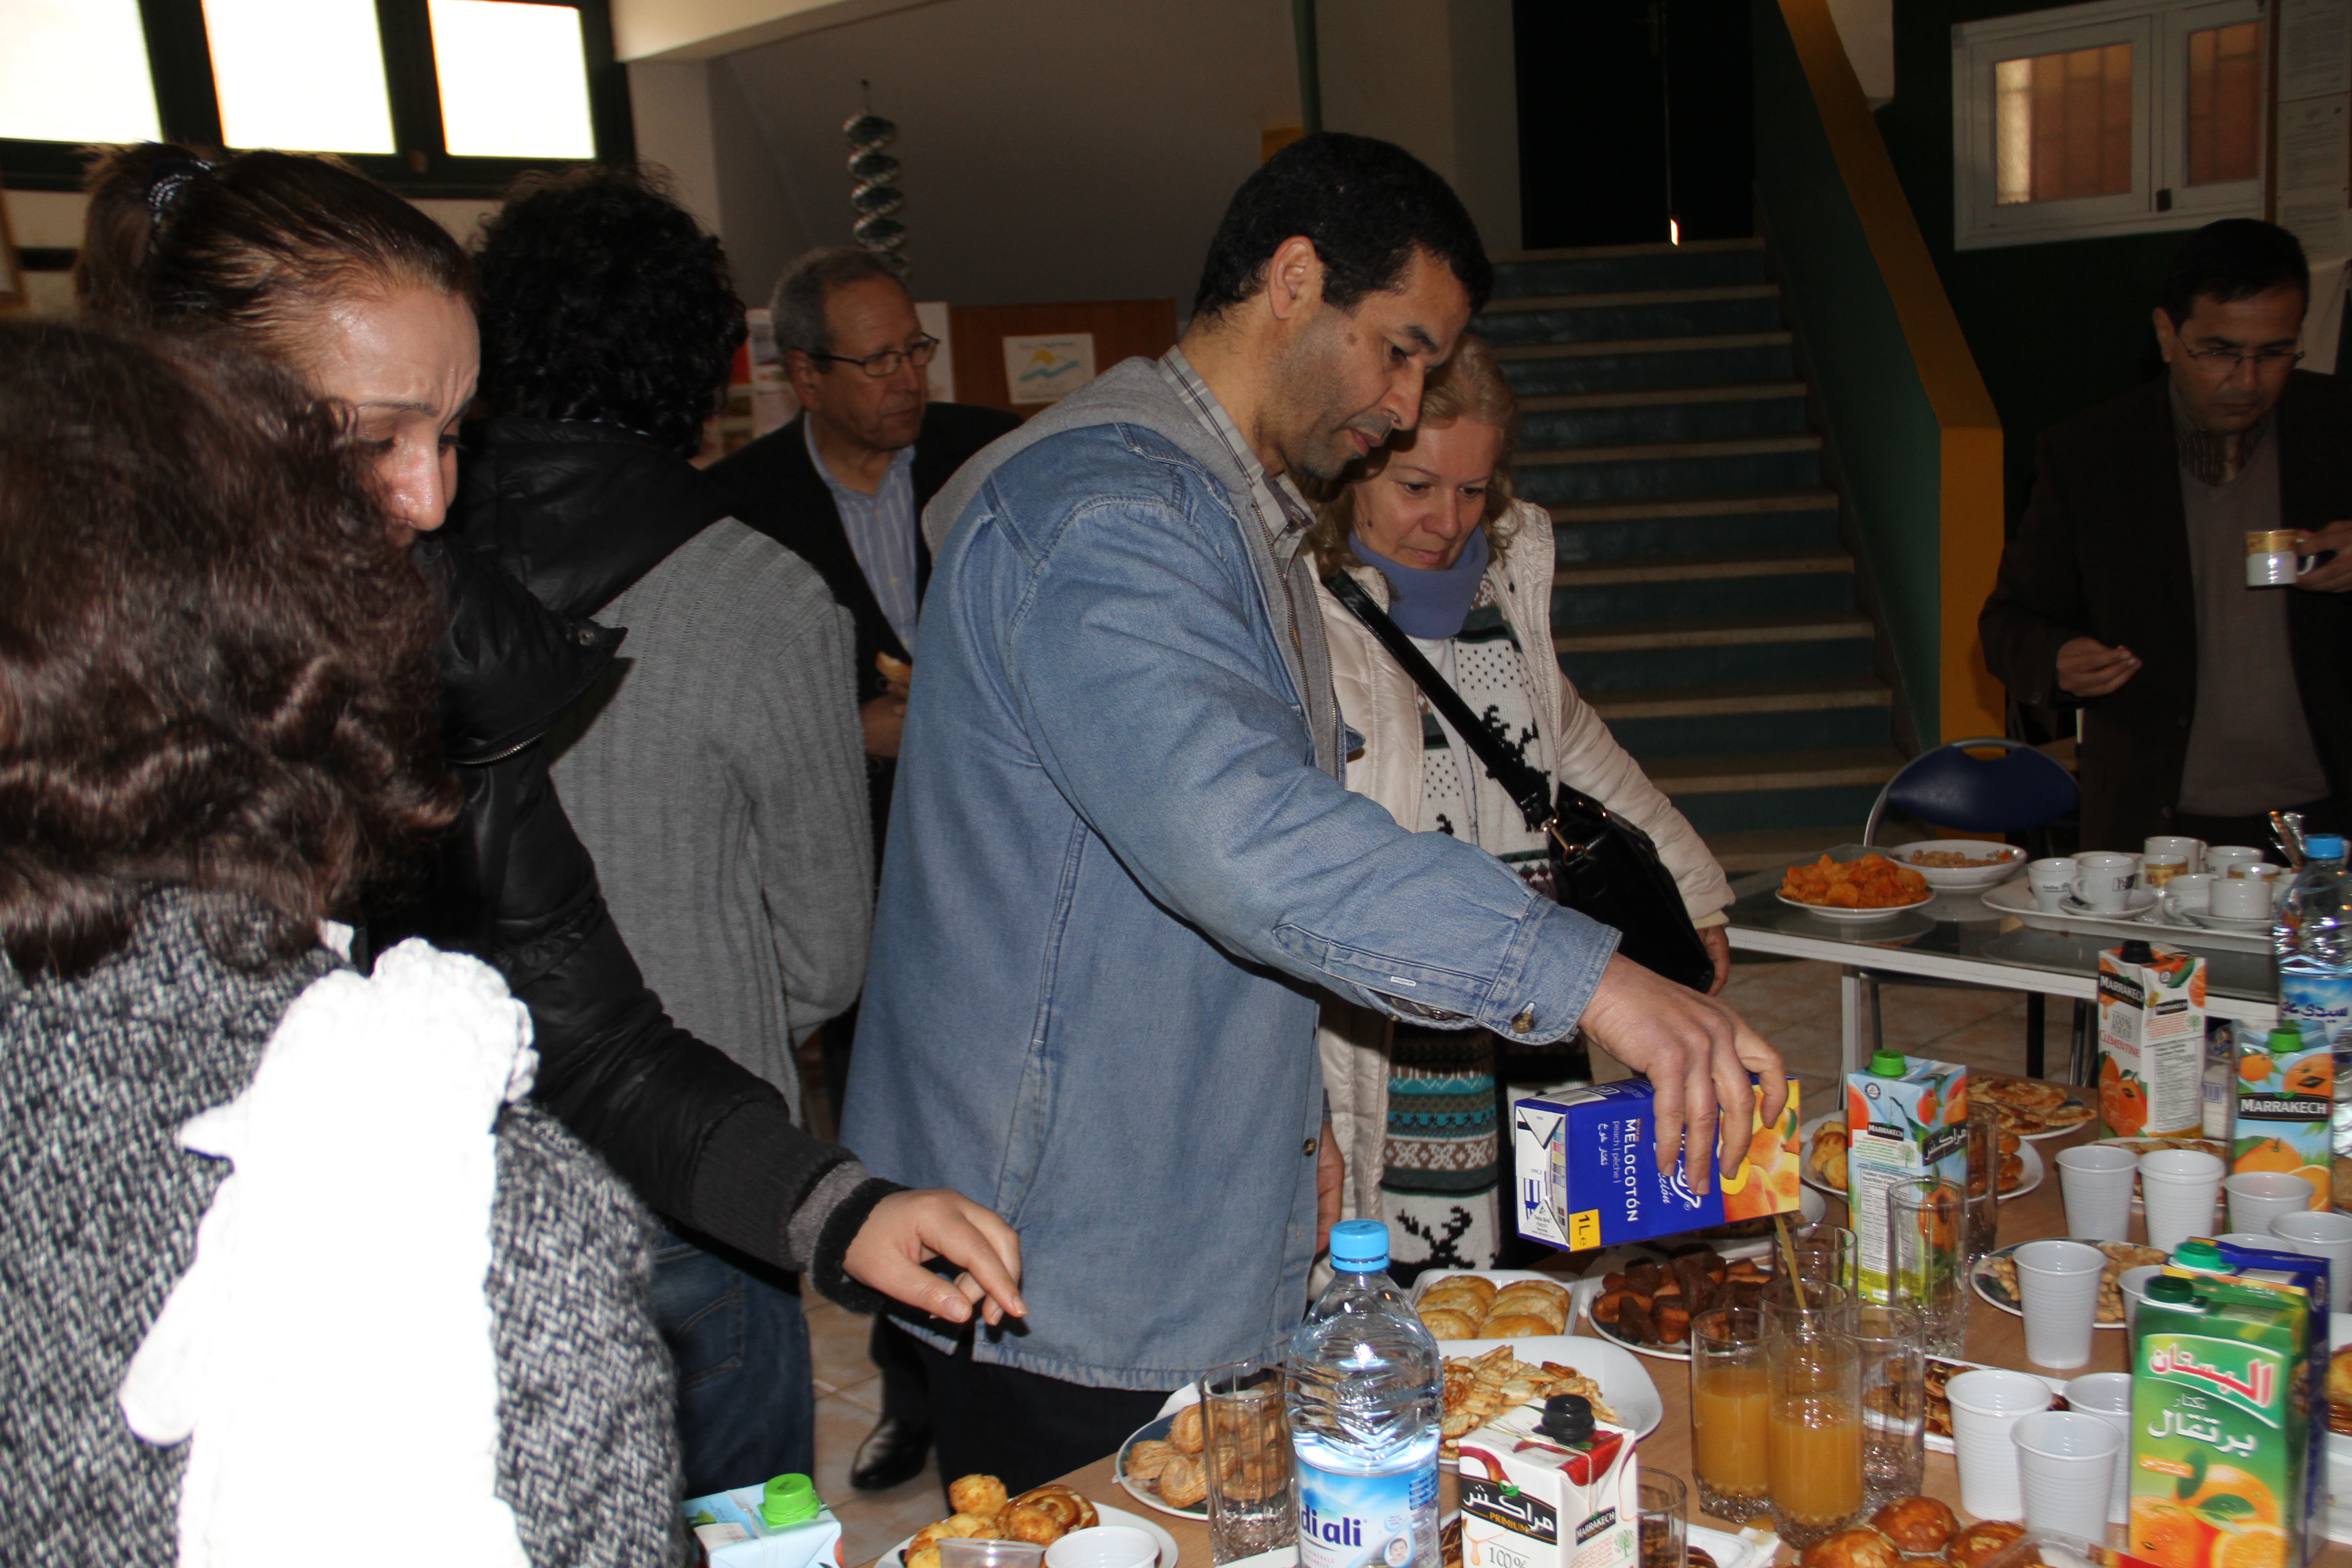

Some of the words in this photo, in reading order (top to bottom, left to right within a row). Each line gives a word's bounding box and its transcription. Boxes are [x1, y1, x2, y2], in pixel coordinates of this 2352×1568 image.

[2100, 975, 2144, 1002] MARRAKECH
[2240, 1099, 2328, 1114] MARRAKECH
[1612, 1120, 1621, 1147] peach
[1868, 1124, 1904, 1138] MARRAKECH
[1611, 1153, 1621, 1179] pêche
[1624, 1118, 1641, 1222] MELOCOTÓN
[2149, 1342, 2274, 1409] البستان
[2147, 1408, 2257, 1458] برتقال
[1463, 1484, 1555, 1533] مراكش
[1322, 1516, 1362, 1547] ali
[1576, 1511, 1615, 1540] MARRAKECH
